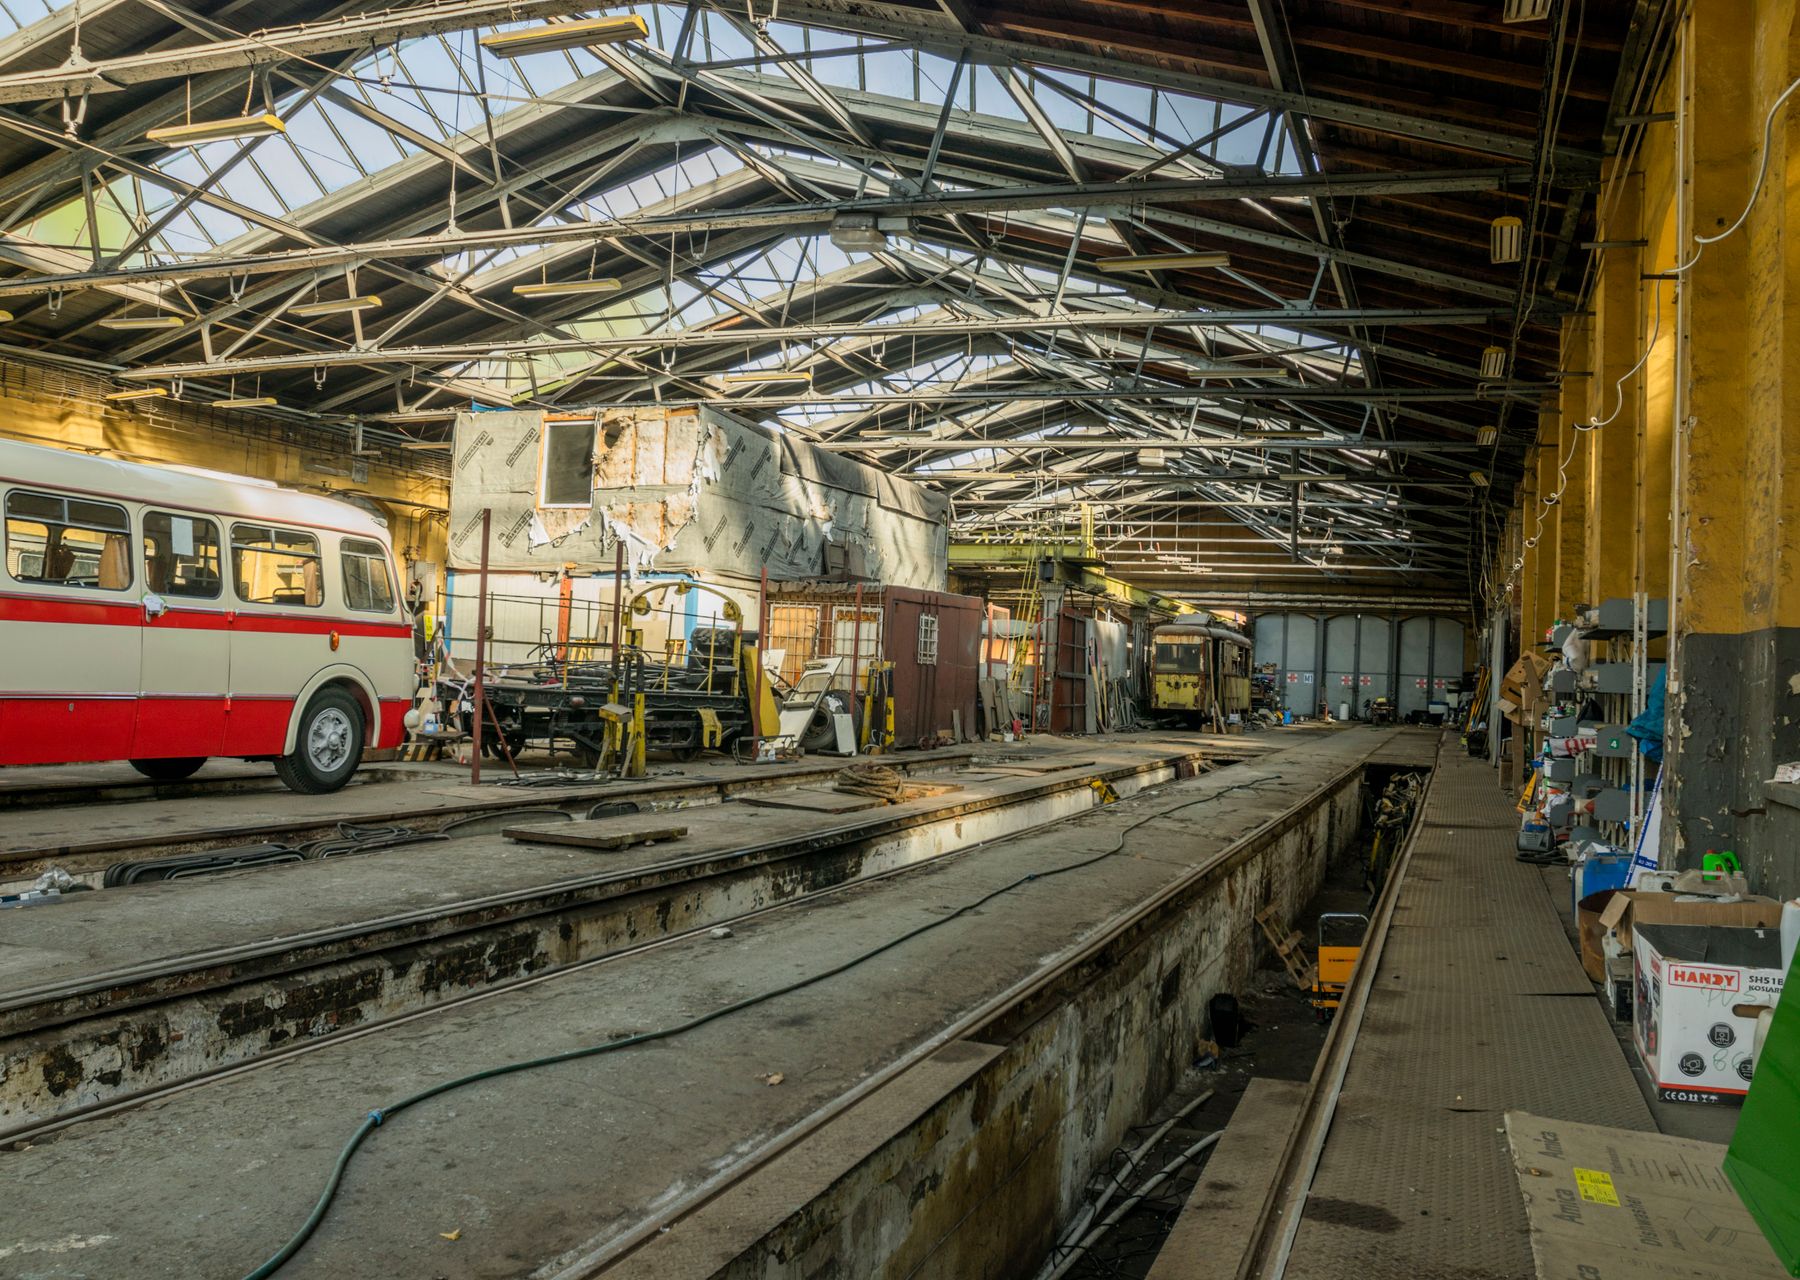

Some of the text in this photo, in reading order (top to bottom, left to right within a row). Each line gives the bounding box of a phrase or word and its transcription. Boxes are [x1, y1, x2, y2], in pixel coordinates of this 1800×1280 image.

[1673, 970, 1736, 987] HANDY
[1532, 1130, 1566, 1160] Amica
[1546, 1188, 1584, 1225] Amica
